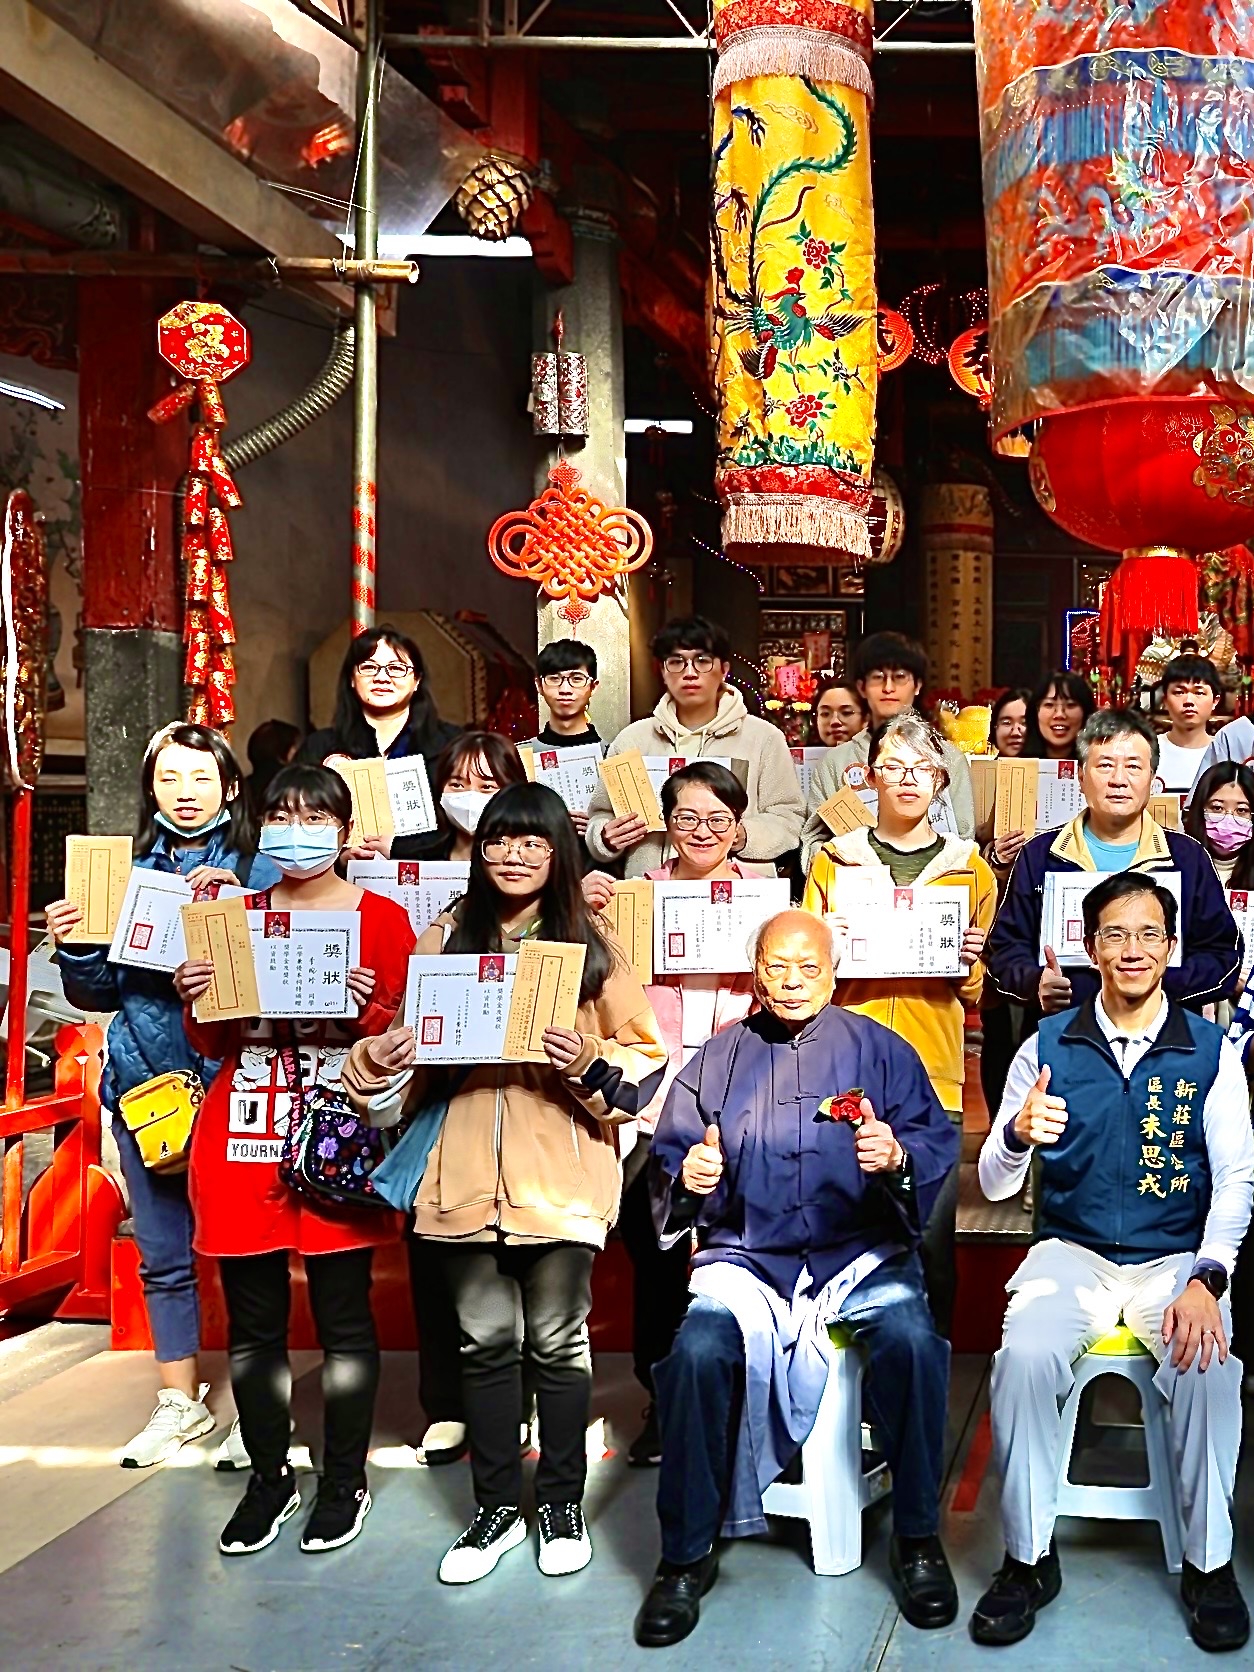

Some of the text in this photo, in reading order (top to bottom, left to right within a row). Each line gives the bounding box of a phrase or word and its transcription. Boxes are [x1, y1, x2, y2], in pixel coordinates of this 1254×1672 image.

[402, 780, 421, 811] 獎狀
[940, 914, 955, 949] 獎狀
[322, 944, 343, 985] 獎狀
[1169, 1078, 1198, 1193] 新莊區公所
